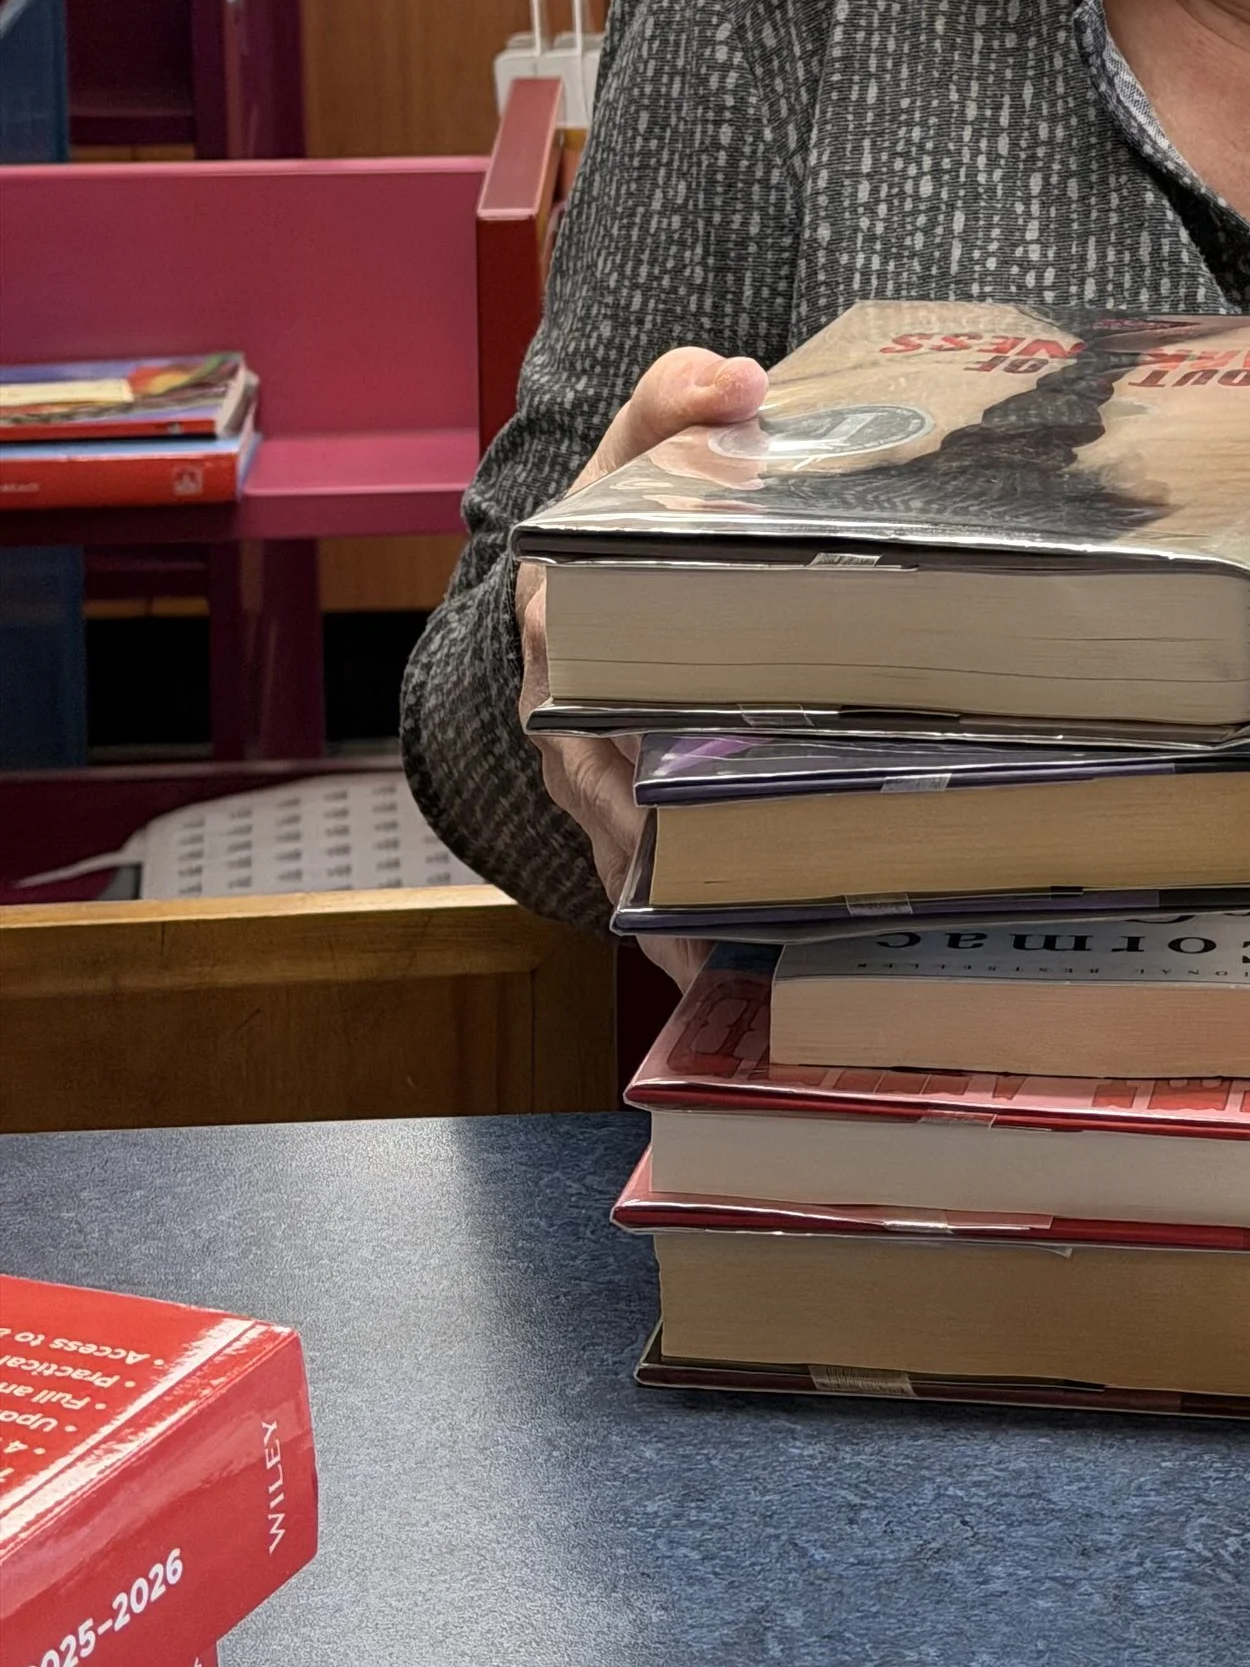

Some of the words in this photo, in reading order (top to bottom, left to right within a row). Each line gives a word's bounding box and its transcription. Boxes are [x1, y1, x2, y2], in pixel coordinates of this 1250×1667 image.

[880, 333, 1086, 359] NESS
[963, 355, 1050, 374] OF
[14, 1331, 45, 1347] to
[49, 1337, 151, 1365] Access
[0, 1355, 121, 1388] Practical
[31, 1390, 91, 1410] Full
[261, 1421, 286, 1554] WILEY
[27, 1548, 183, 1667] 025-2026
